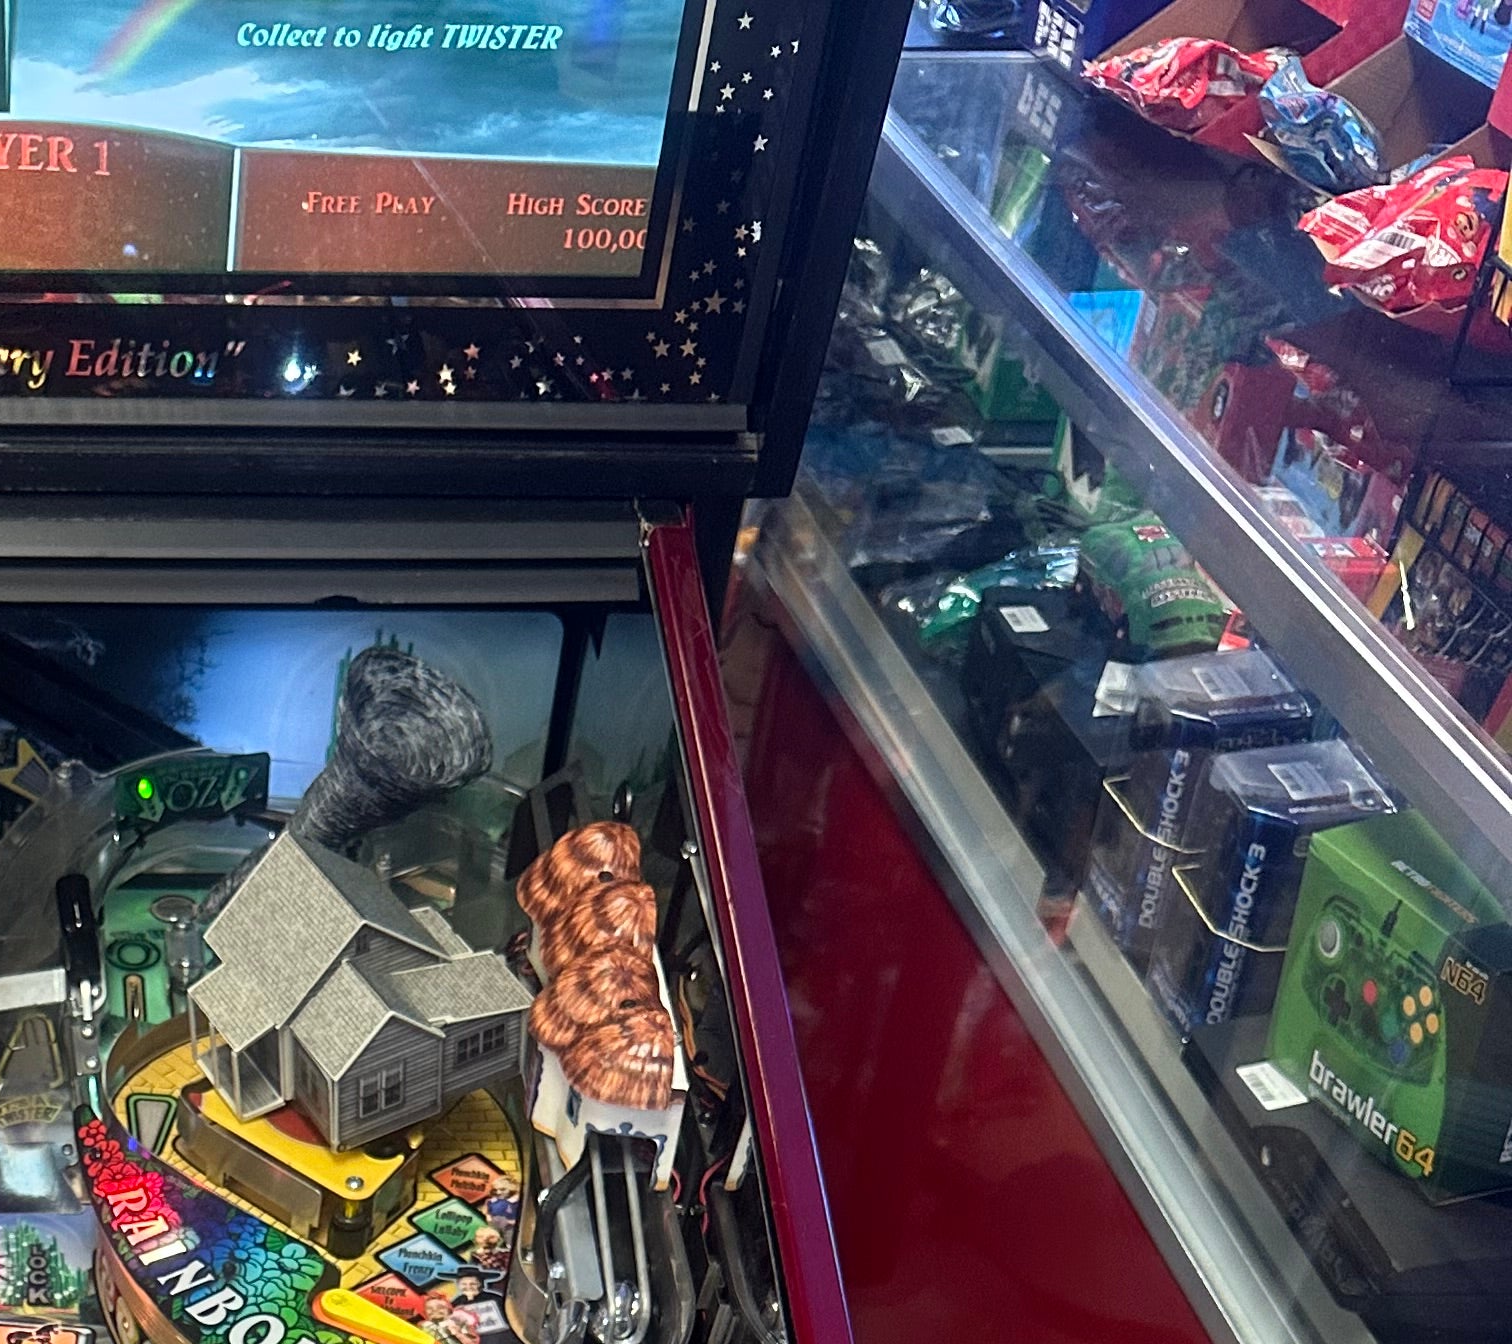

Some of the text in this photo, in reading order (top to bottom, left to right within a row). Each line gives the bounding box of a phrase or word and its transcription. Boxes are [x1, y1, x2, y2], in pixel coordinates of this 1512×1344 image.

[236, 22, 563, 51] Collect to light TWISTER
[93, 139, 110, 177] 1
[1442, 957, 1487, 1005] N64
[28, 1243, 51, 1305] LOCK
